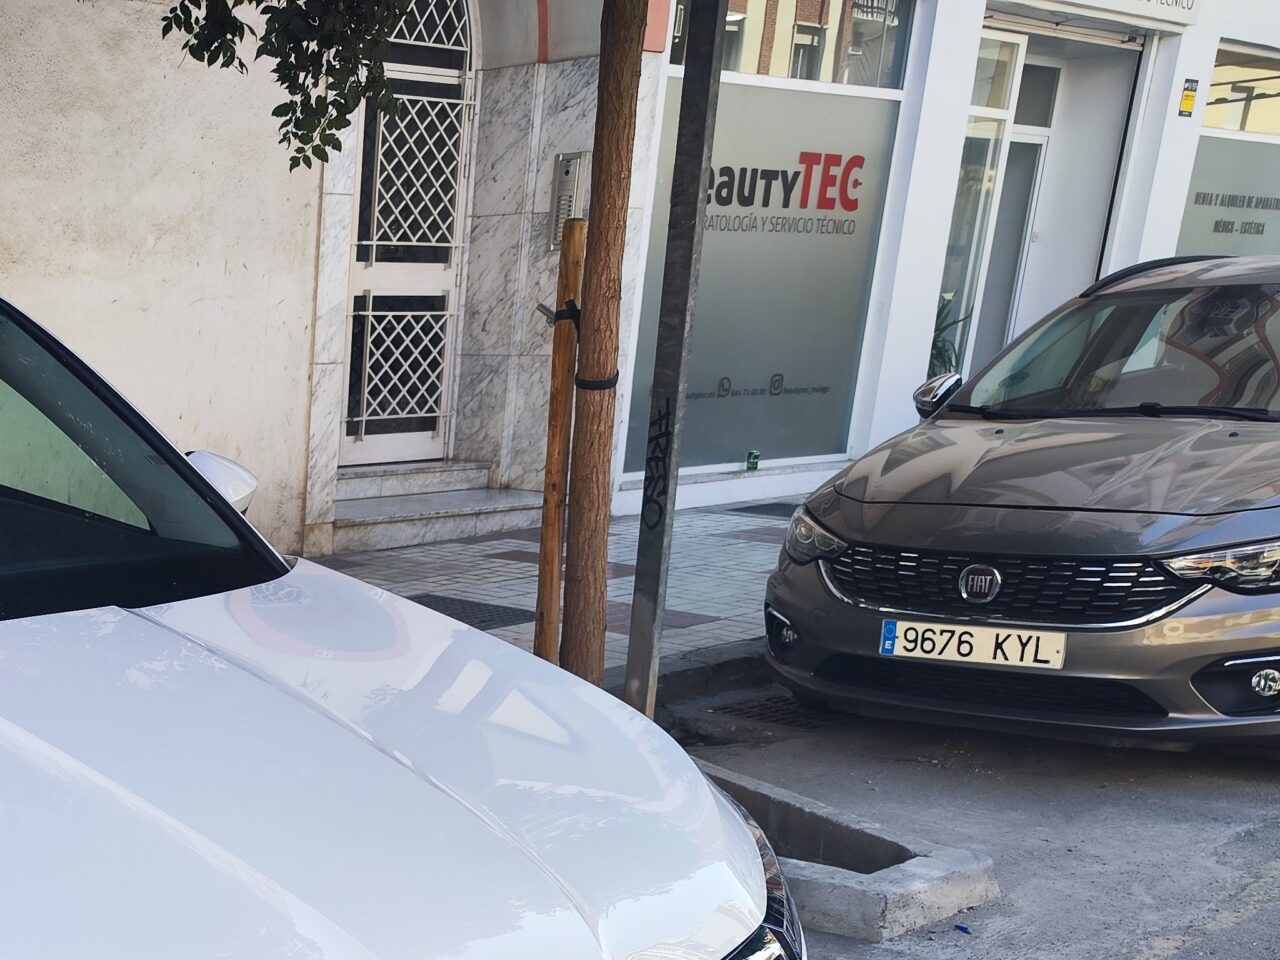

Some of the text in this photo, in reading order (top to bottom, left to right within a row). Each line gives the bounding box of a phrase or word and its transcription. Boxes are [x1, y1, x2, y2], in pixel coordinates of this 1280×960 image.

[761, 216, 768, 232] Y
[770, 216, 813, 234] SERVICIO
[816, 215, 856, 235] TÉCNICO
[967, 575, 993, 593] FIAT
[884, 626, 1051, 665] E 9676 KYL
